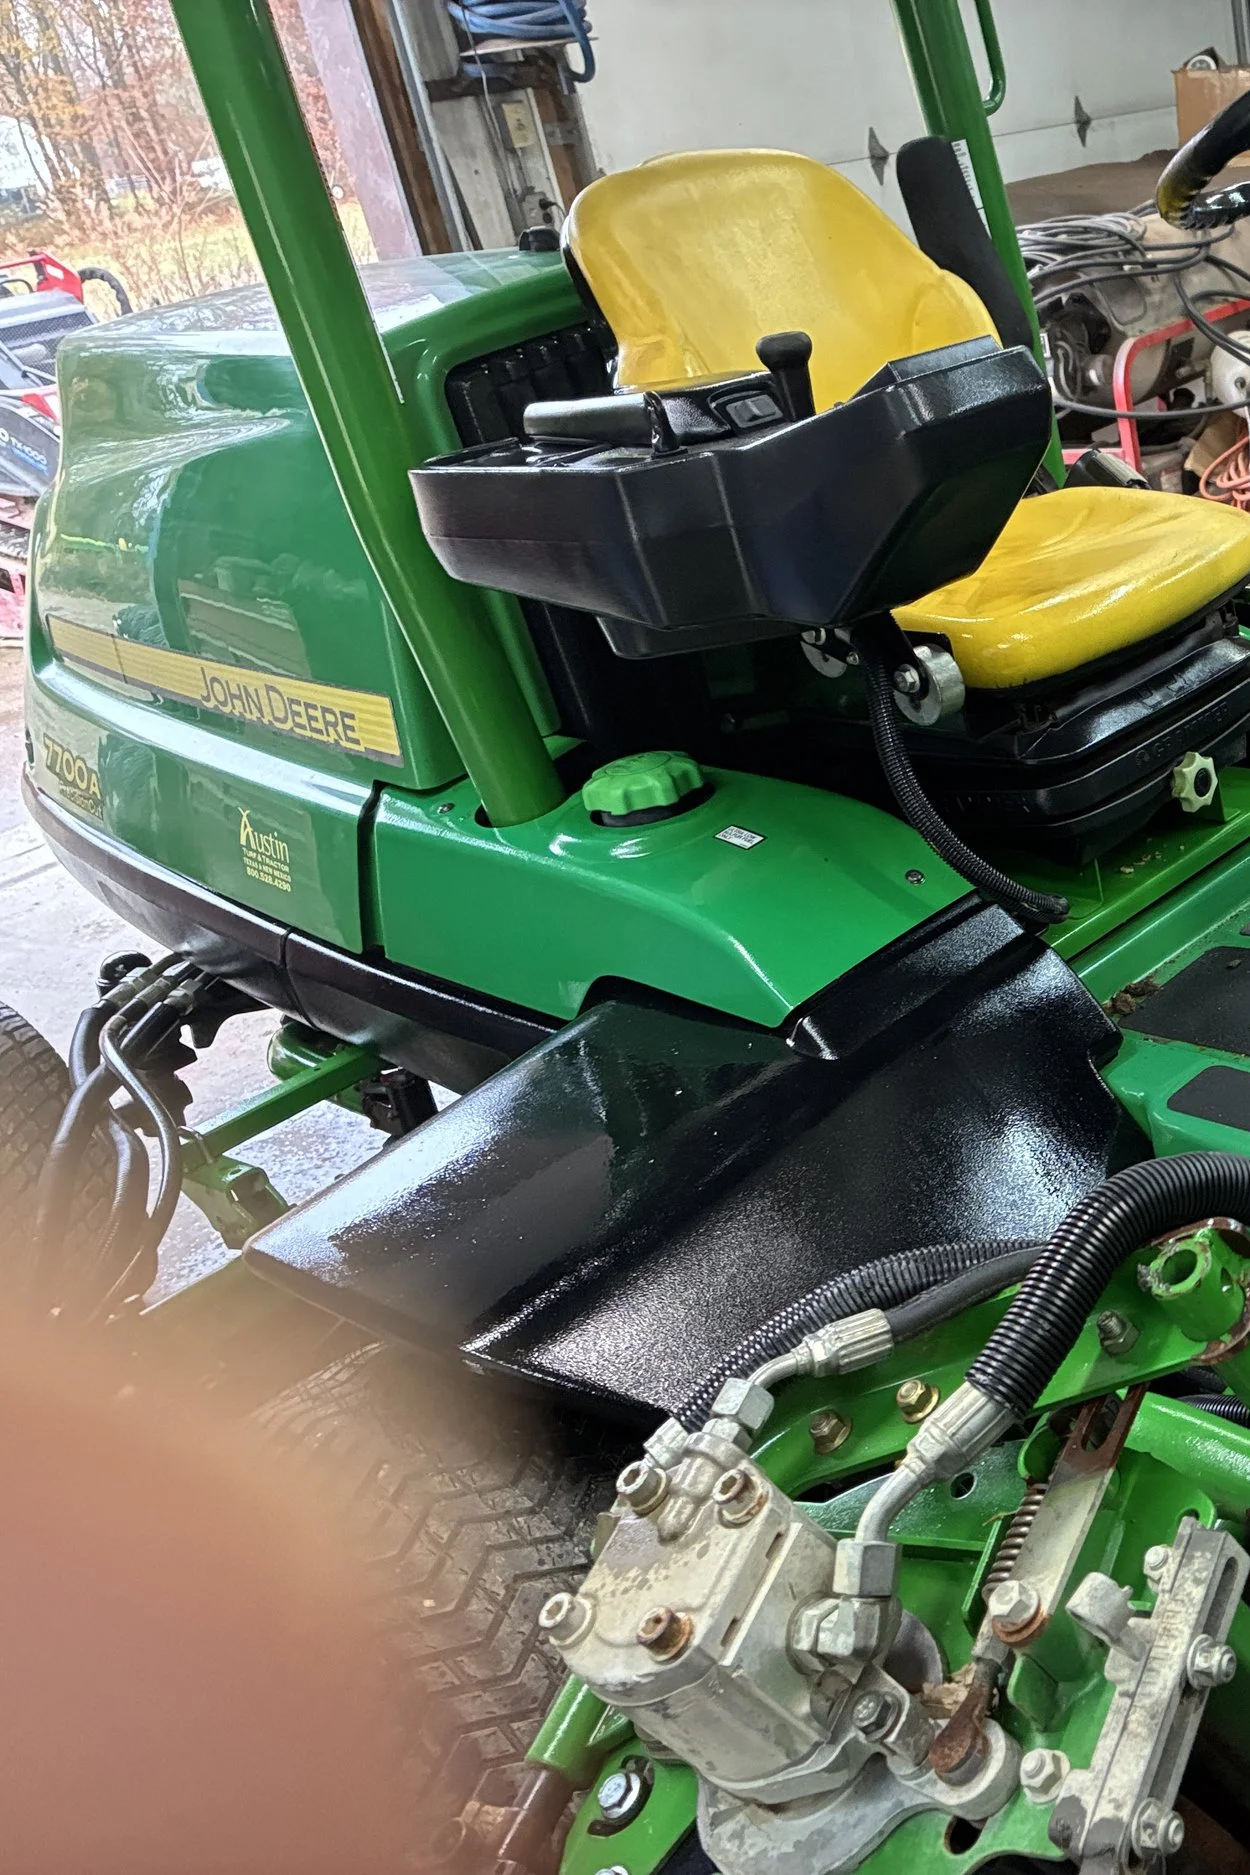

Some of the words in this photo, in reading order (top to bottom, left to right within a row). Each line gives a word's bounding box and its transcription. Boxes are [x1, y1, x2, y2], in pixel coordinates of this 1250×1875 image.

[200, 667, 265, 719] JOHN
[264, 683, 361, 746] DEERE
[43, 734, 102, 801] 7700A
[237, 807, 290, 864] Austin
